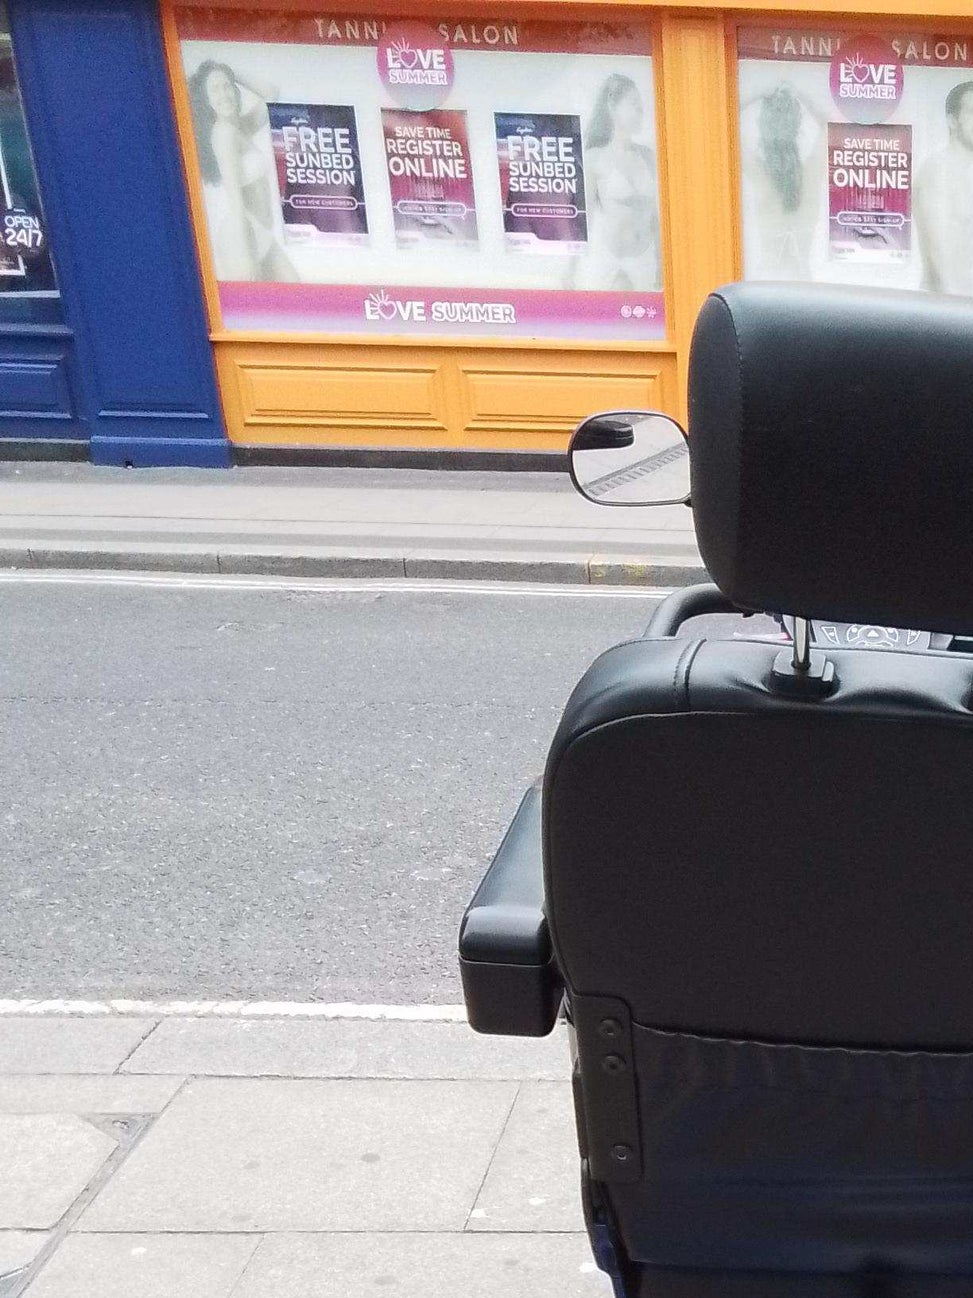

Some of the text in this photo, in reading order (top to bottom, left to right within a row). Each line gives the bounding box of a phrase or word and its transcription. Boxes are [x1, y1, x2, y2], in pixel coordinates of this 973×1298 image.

[438, 23, 519, 45] SALON
[891, 40, 968, 61] SALON
[389, 69, 447, 85] SUMMER
[839, 84, 896, 99] SUMMER
[282, 126, 352, 153] FREE
[395, 126, 452, 140] SAVE TIME
[385, 138, 463, 157] REGISTER
[507, 135, 575, 162] FREE
[843, 137, 900, 151] SAVE TIME
[285, 152, 354, 170] SUNBED
[388, 156, 468, 179] ONLINE
[833, 150, 908, 168] REGISTER
[286, 168, 355, 186] SESSION
[508, 161, 576, 178] SUNBED
[508, 177, 577, 194] SESSION
[832, 168, 910, 190] ONLINE
[4, 215, 40, 229] OPEN
[4, 228, 43, 248] 24/7
[431, 302, 517, 324] SUMMER
